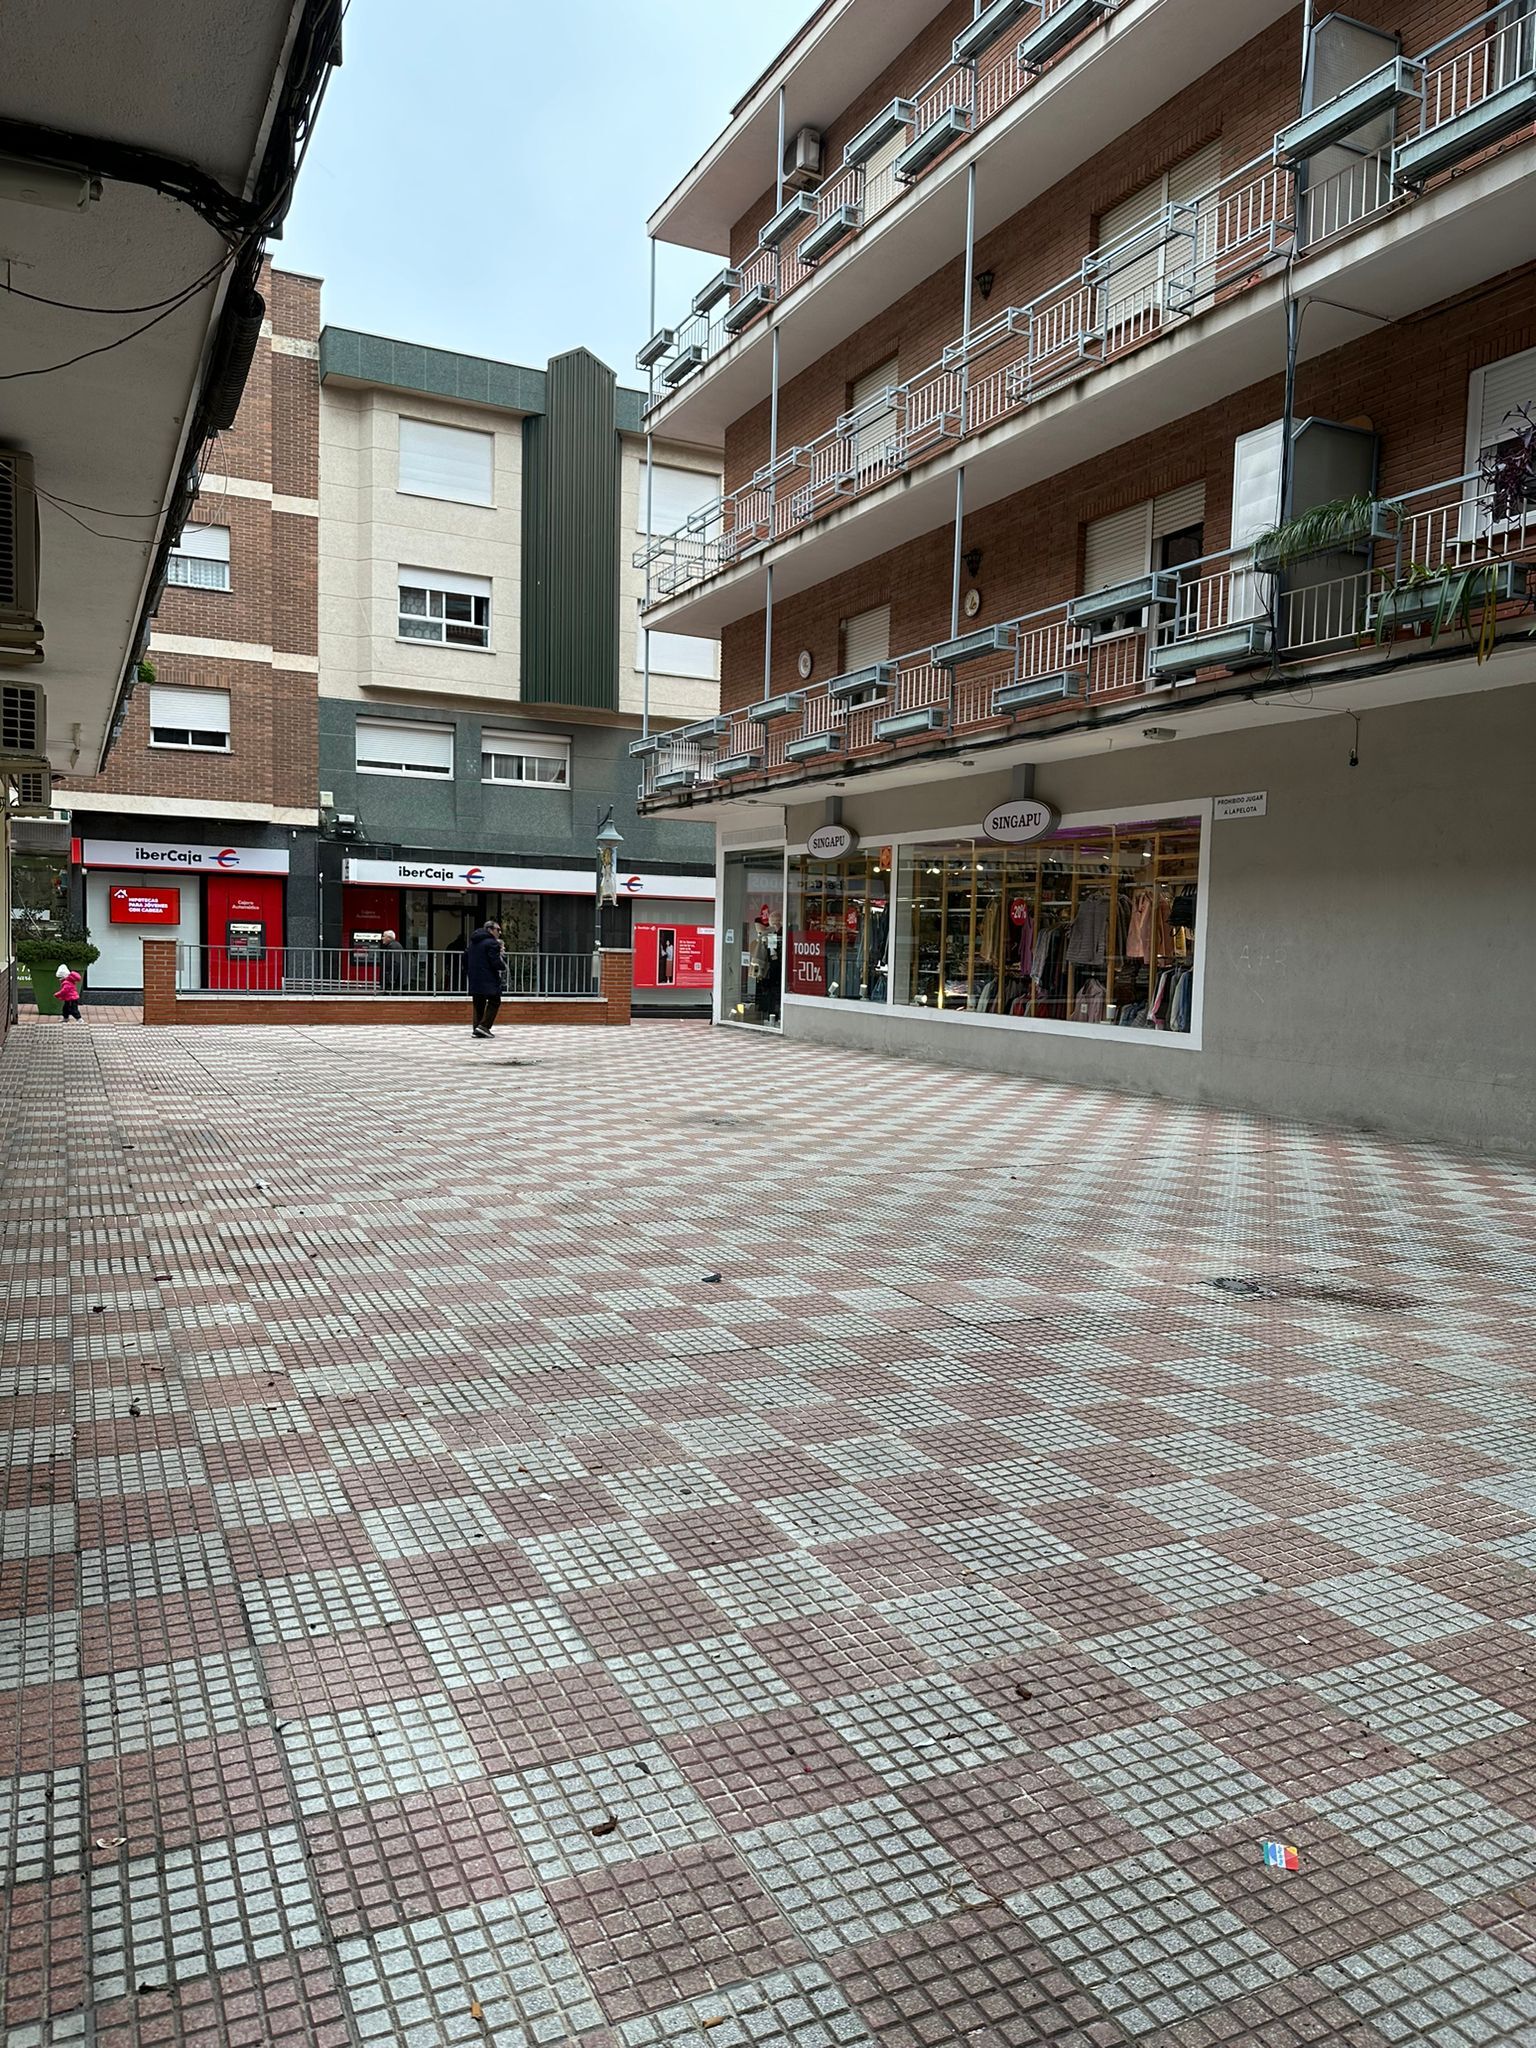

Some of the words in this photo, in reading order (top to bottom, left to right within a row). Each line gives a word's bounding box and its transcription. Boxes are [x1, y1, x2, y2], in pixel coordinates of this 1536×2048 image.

[1217, 797, 1245, 805] PROHIBIDO
[1245, 794, 1263, 802] JUGAR
[1236, 806, 1257, 814] PELOTA
[991, 811, 1042, 830] SINGAPU
[813, 834, 845, 850] SINGAPU
[135, 848, 202, 865] iberCaja
[398, 866, 454, 882] iberCaja
[793, 941, 821, 956] TODOS
[792, 960, 823, 982] -20%
